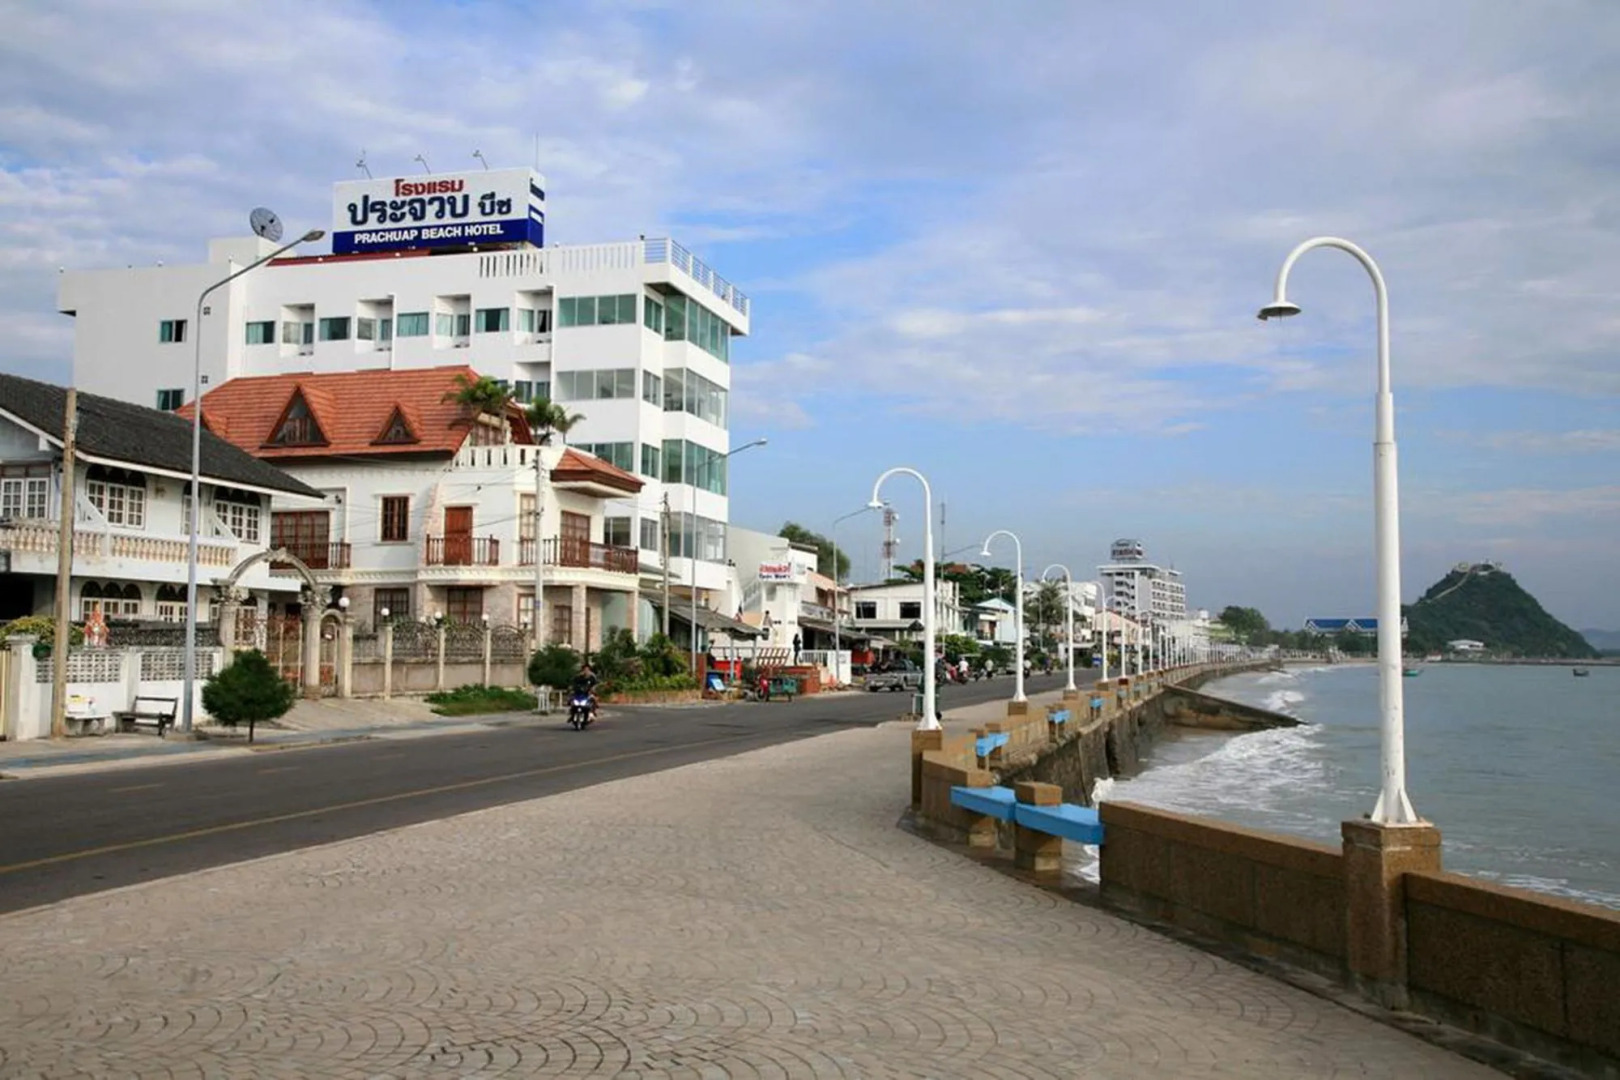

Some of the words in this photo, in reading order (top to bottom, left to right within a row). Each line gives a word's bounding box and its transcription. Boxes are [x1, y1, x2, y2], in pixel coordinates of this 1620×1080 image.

[395, 179, 464, 197] โรงแรม
[347, 194, 469, 226] ประจวบ
[354, 230, 418, 244] PRACHUAP
[421, 226, 462, 240] BEACH
[464, 223, 504, 237] HOTEL
